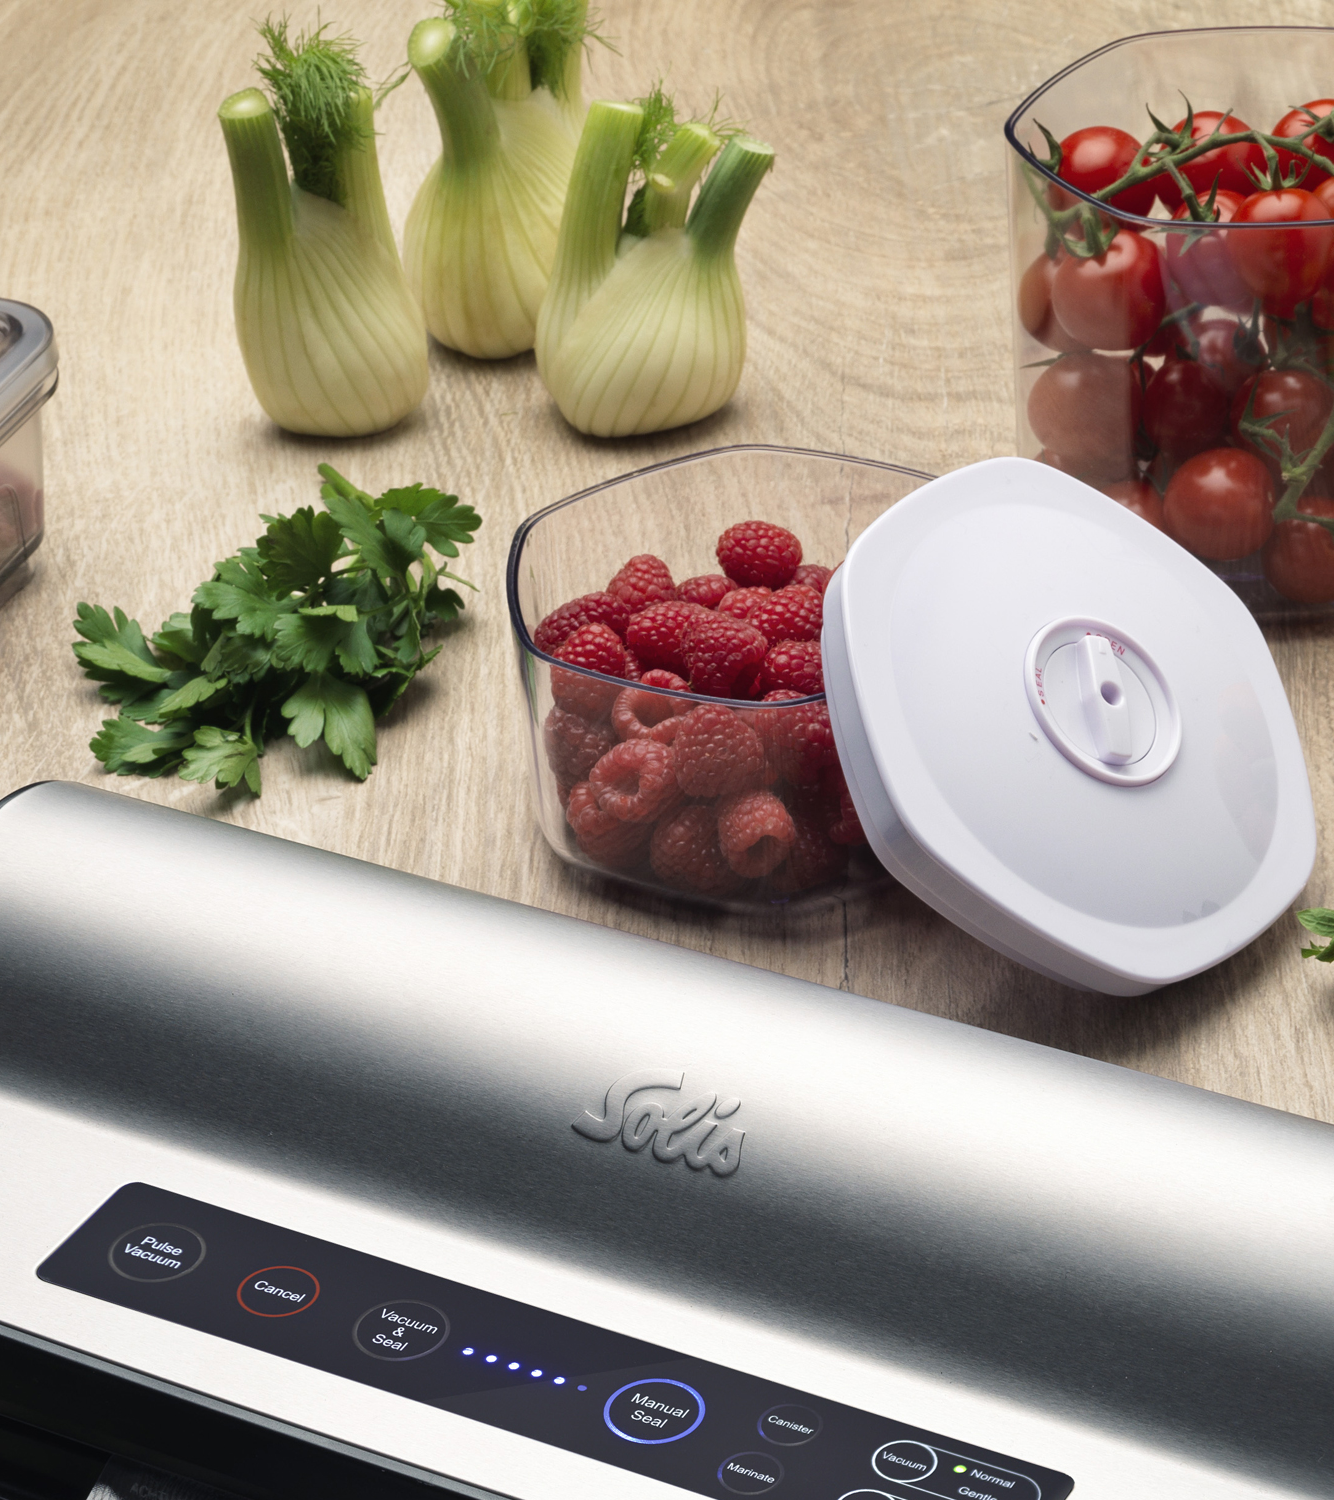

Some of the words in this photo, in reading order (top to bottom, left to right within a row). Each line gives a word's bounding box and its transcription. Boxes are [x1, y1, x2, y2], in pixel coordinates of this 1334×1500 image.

[1035, 667, 1045, 698] SEAL
[571, 1068, 746, 1178] Solis
[124, 1243, 182, 1269] Vacuum
[140, 1236, 183, 1256] Pulse
[254, 1280, 306, 1303] Cancel
[381, 1308, 438, 1335] Vacuum
[392, 1326, 405, 1338] &
[372, 1333, 408, 1351] Seal
[631, 1393, 690, 1419] Manual
[630, 1410, 668, 1429] Seal
[768, 1415, 814, 1436] Canister
[882, 1451, 927, 1471] Vacuum
[727, 1462, 775, 1484] Marinate
[970, 1469, 1016, 1489] Normal
